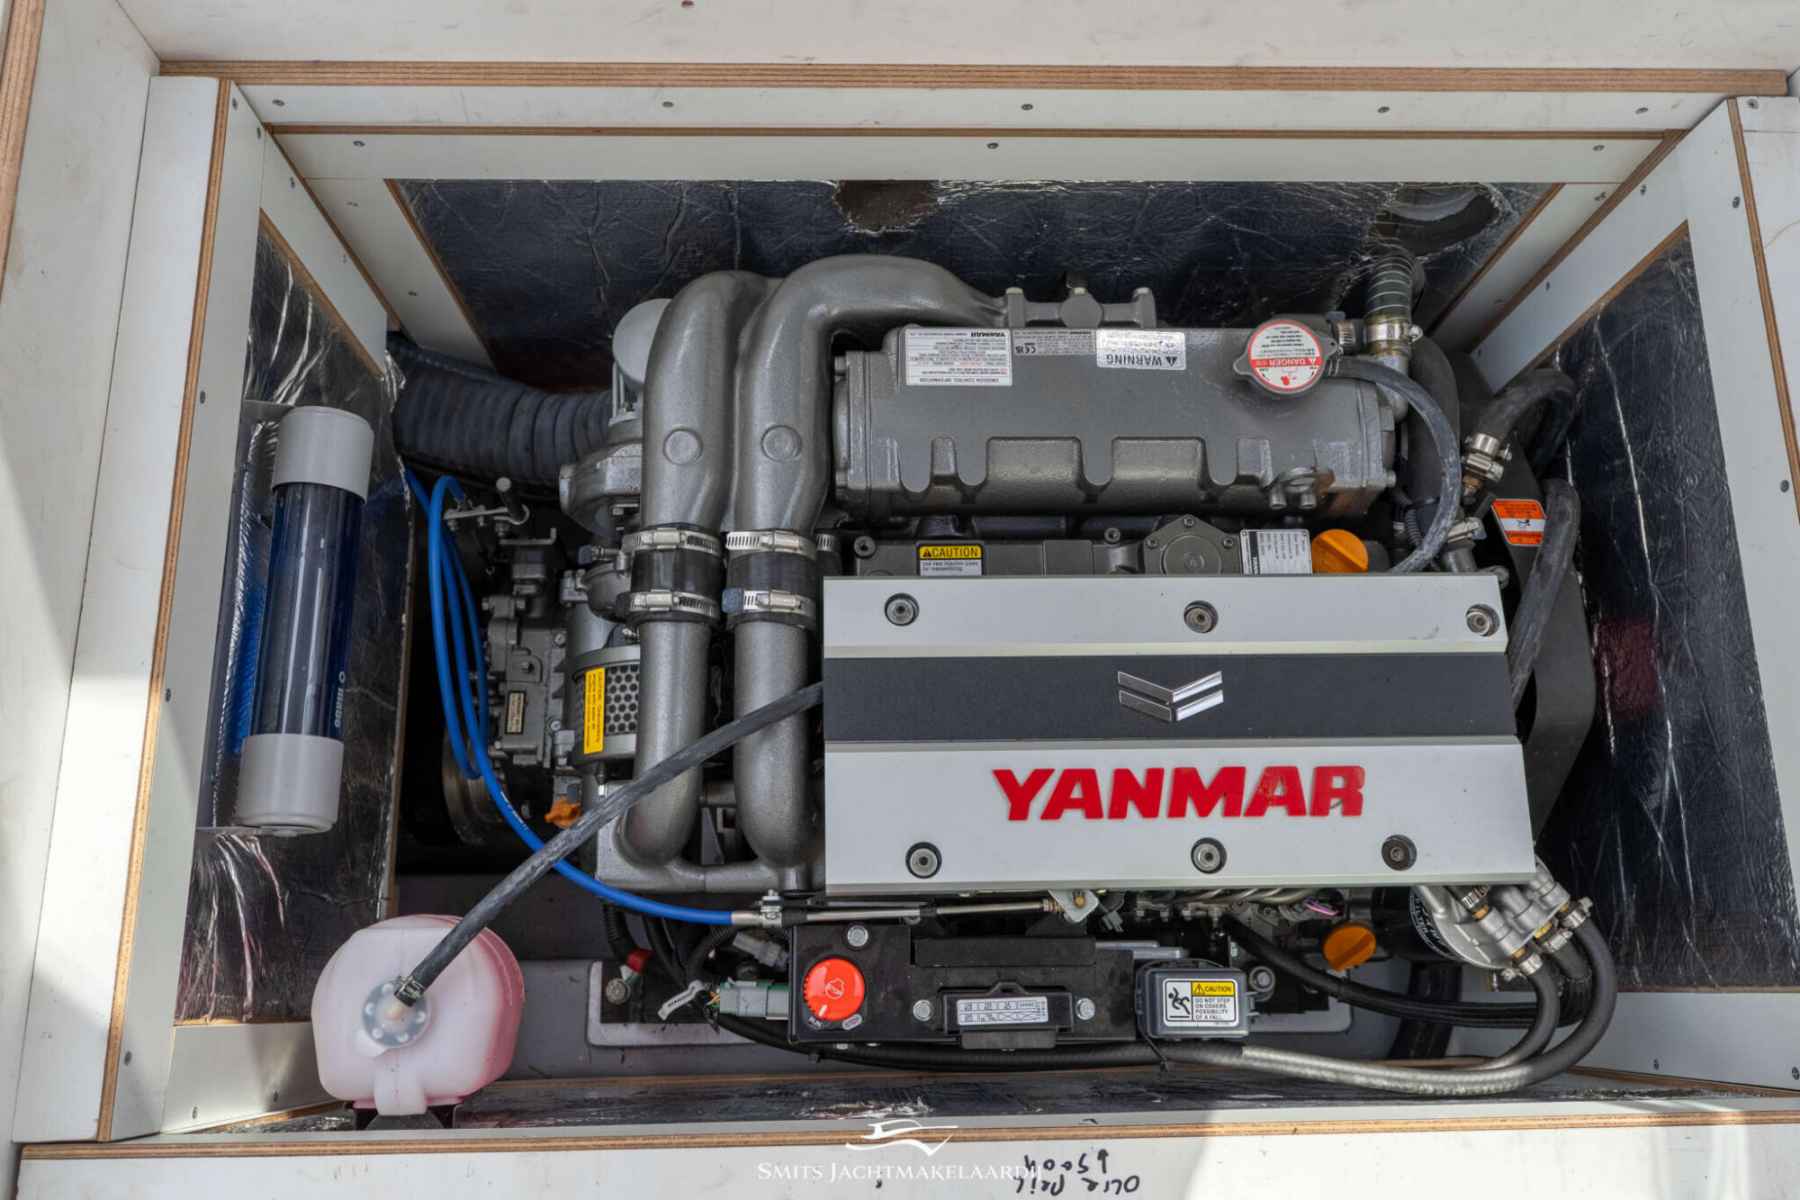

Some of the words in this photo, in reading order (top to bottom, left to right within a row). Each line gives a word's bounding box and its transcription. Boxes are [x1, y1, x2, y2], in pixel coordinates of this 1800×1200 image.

[1105, 354, 1163, 366] WARNING
[1268, 358, 1306, 367] DANGER
[931, 547, 979, 557] CAUTION
[992, 765, 1366, 821] YANMAR
